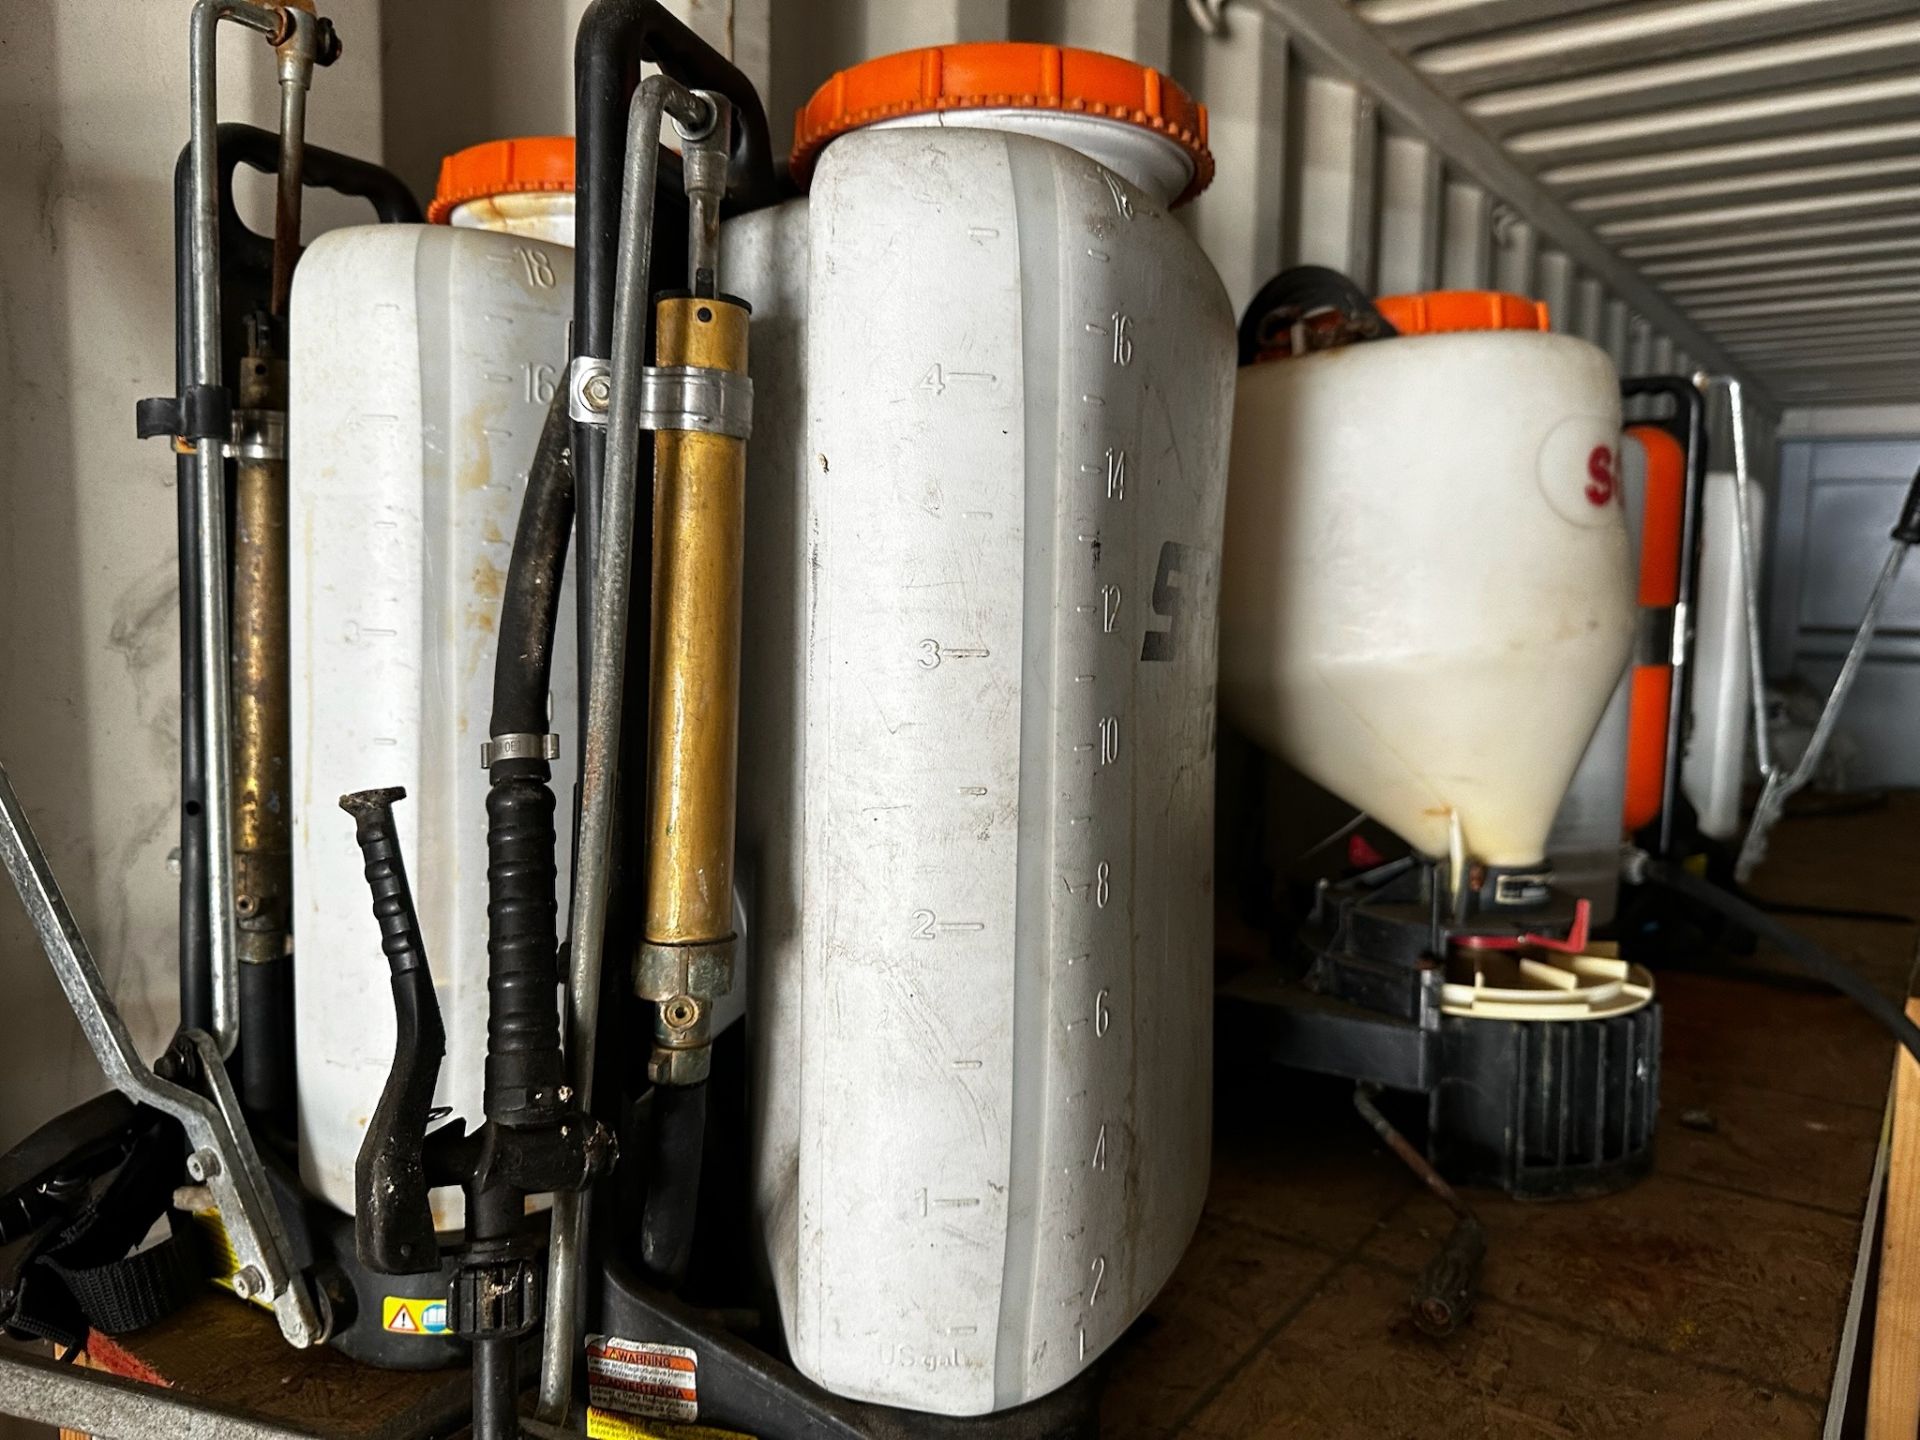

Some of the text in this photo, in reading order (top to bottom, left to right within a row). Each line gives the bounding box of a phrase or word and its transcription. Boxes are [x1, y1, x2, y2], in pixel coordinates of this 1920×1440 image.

[513, 246, 557, 289] 18
[1110, 311, 1134, 367] 16
[520, 361, 556, 405] 16
[919, 362, 947, 395] 4
[1105, 447, 1126, 501] 14
[1101, 583, 1122, 633] 12
[917, 637, 942, 671] 3
[1098, 716, 1119, 766] 10
[1097, 860, 1110, 909] 8
[911, 908, 937, 941] 2
[1095, 988, 1109, 1038] 6
[1092, 1123, 1106, 1172] 4
[915, 1186, 928, 1218] 1
[1089, 1255, 1106, 1307] 2
[618, 1350, 672, 1369] WARNING
[607, 1378, 684, 1399] ADVERTENCIA
